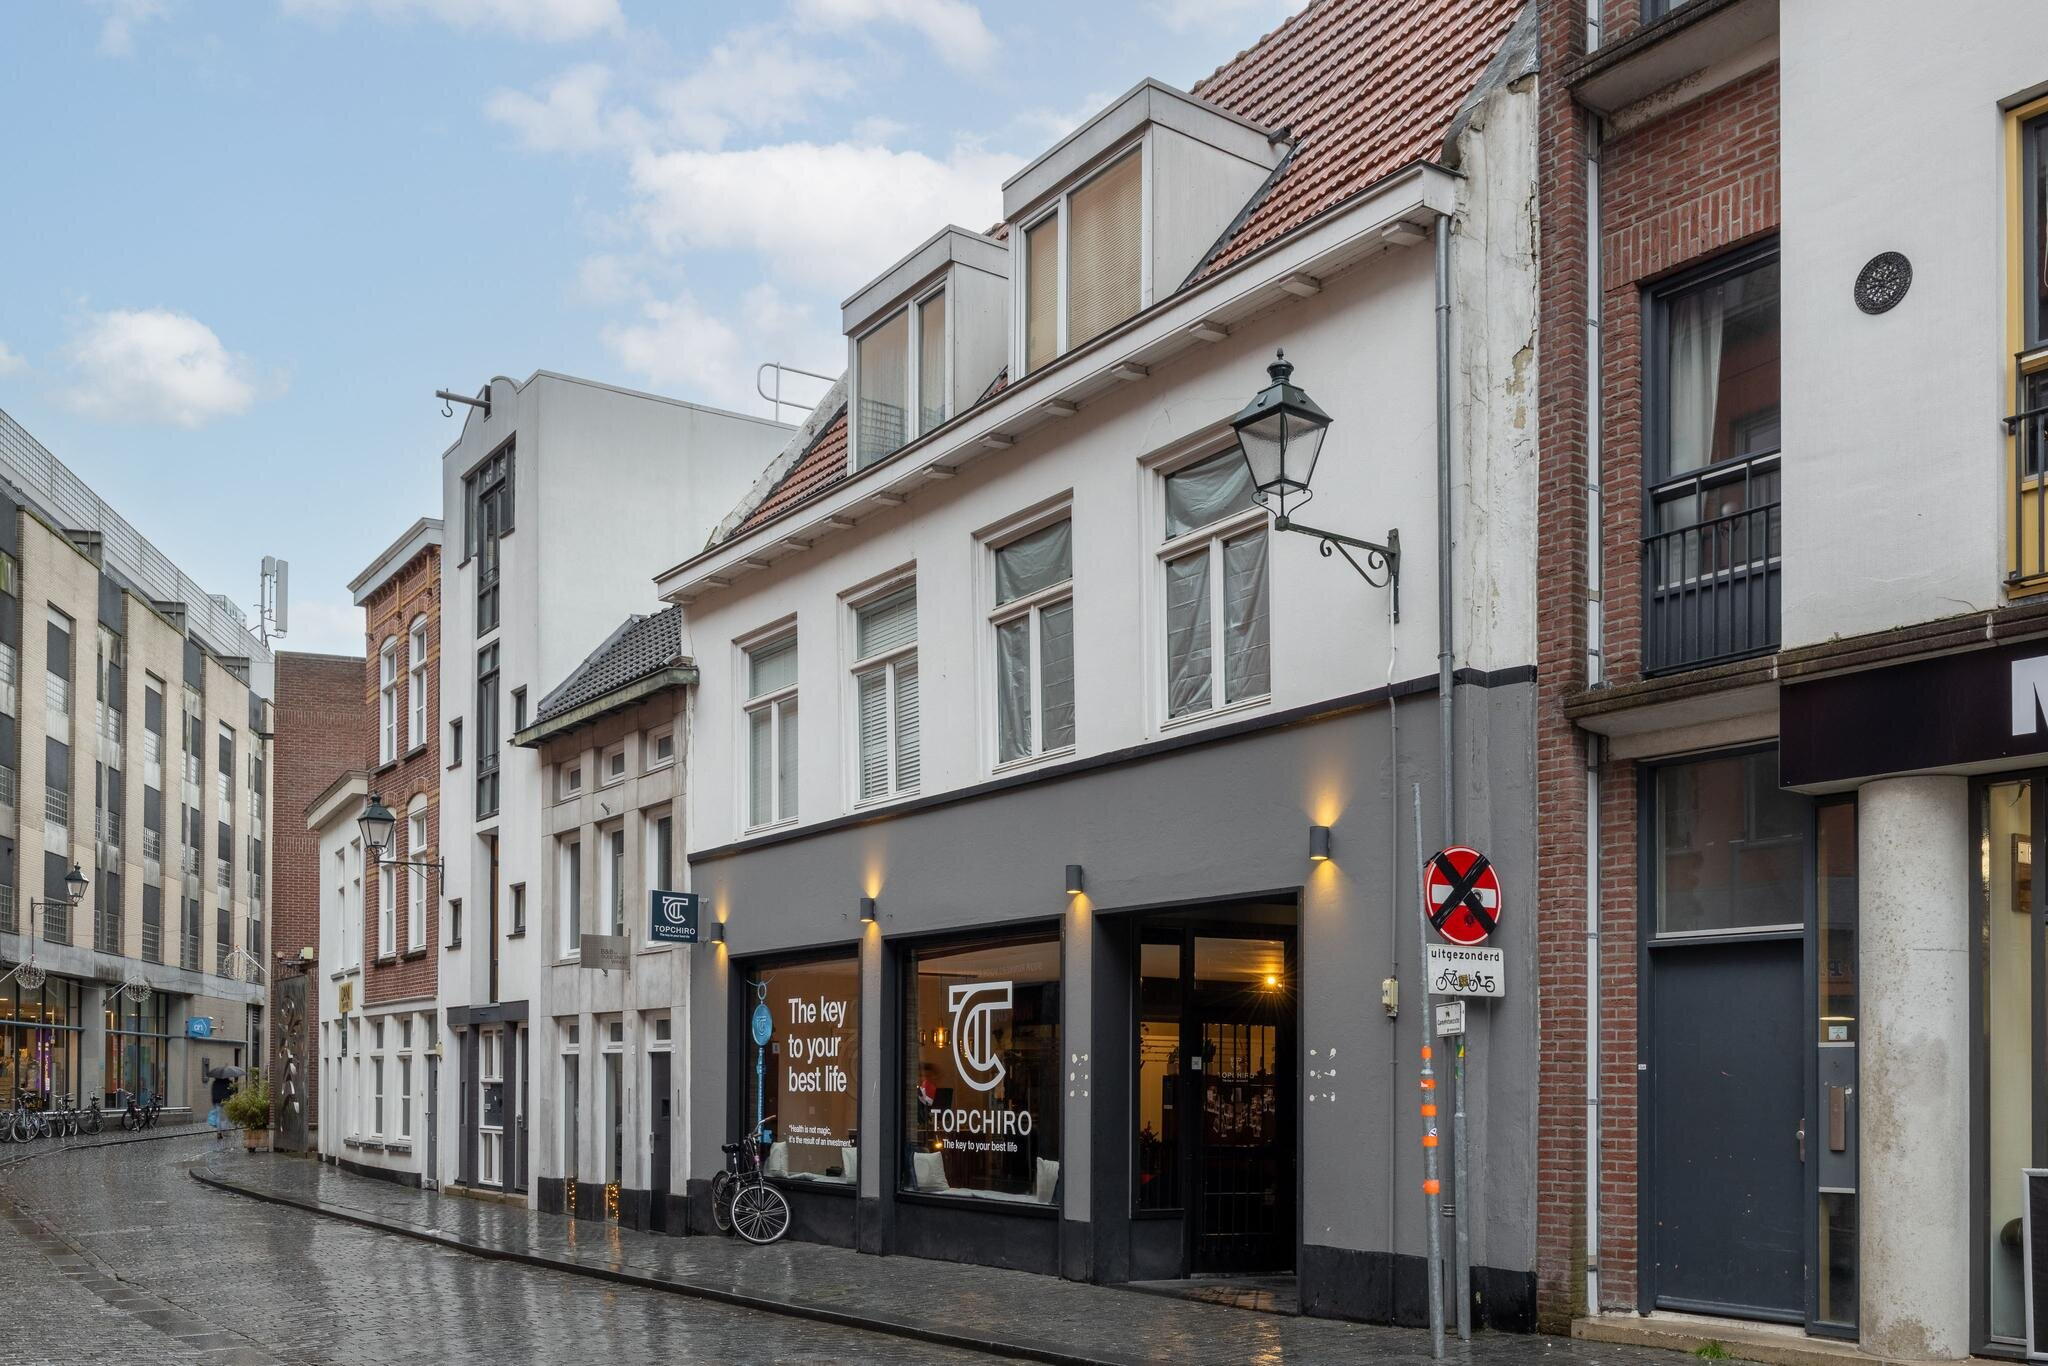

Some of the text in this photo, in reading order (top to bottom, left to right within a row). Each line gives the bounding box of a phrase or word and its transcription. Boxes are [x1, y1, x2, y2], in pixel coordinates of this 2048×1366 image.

[654, 925, 696, 935] TOPCHIRO
[1431, 949, 1500, 962] uitgezonderd
[788, 996, 847, 1028] The key
[788, 1034, 841, 1064] to your
[788, 1066, 847, 1092] best life
[931, 1109, 1032, 1136] TOPCHIRO
[805, 1125, 809, 1133] is
[809, 1126, 817, 1134] not
[817, 1126, 832, 1136] magic,
[803, 1137, 815, 1145] result
[943, 1139, 1018, 1152] The key to your best life
